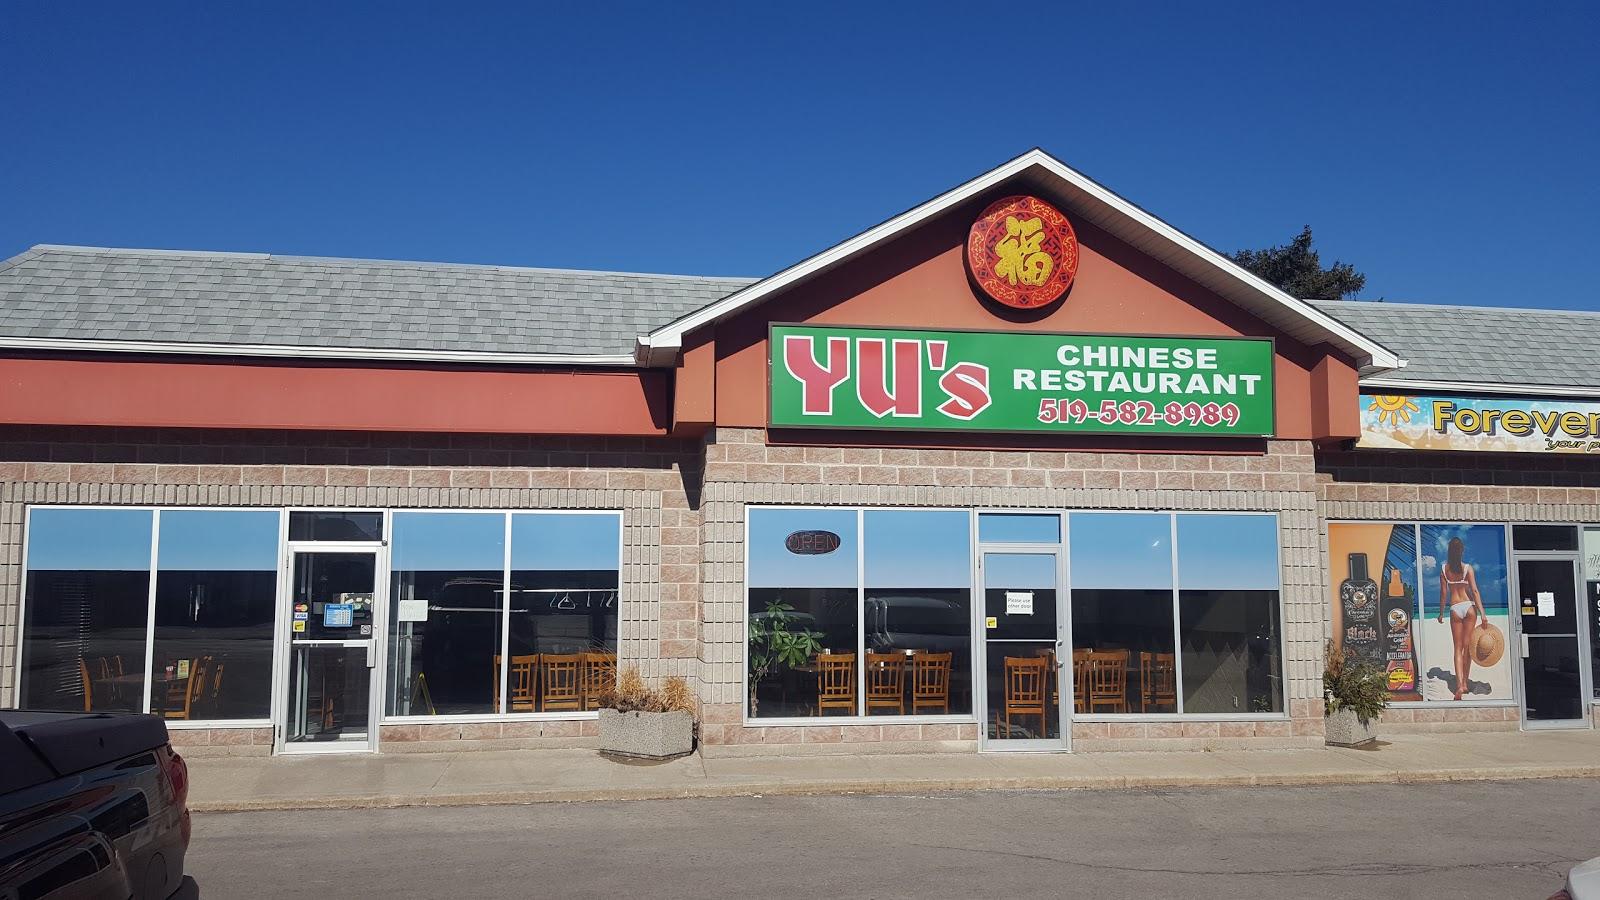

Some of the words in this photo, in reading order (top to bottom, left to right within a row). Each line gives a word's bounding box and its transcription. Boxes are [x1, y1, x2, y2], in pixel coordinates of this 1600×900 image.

[994, 215, 1054, 287] 福
[1056, 344, 1218, 370] CHINESE
[1012, 369, 1262, 396] RESTAURANT
[1037, 398, 1240, 427] 519-582-8989
[788, 534, 838, 551] OPEN
